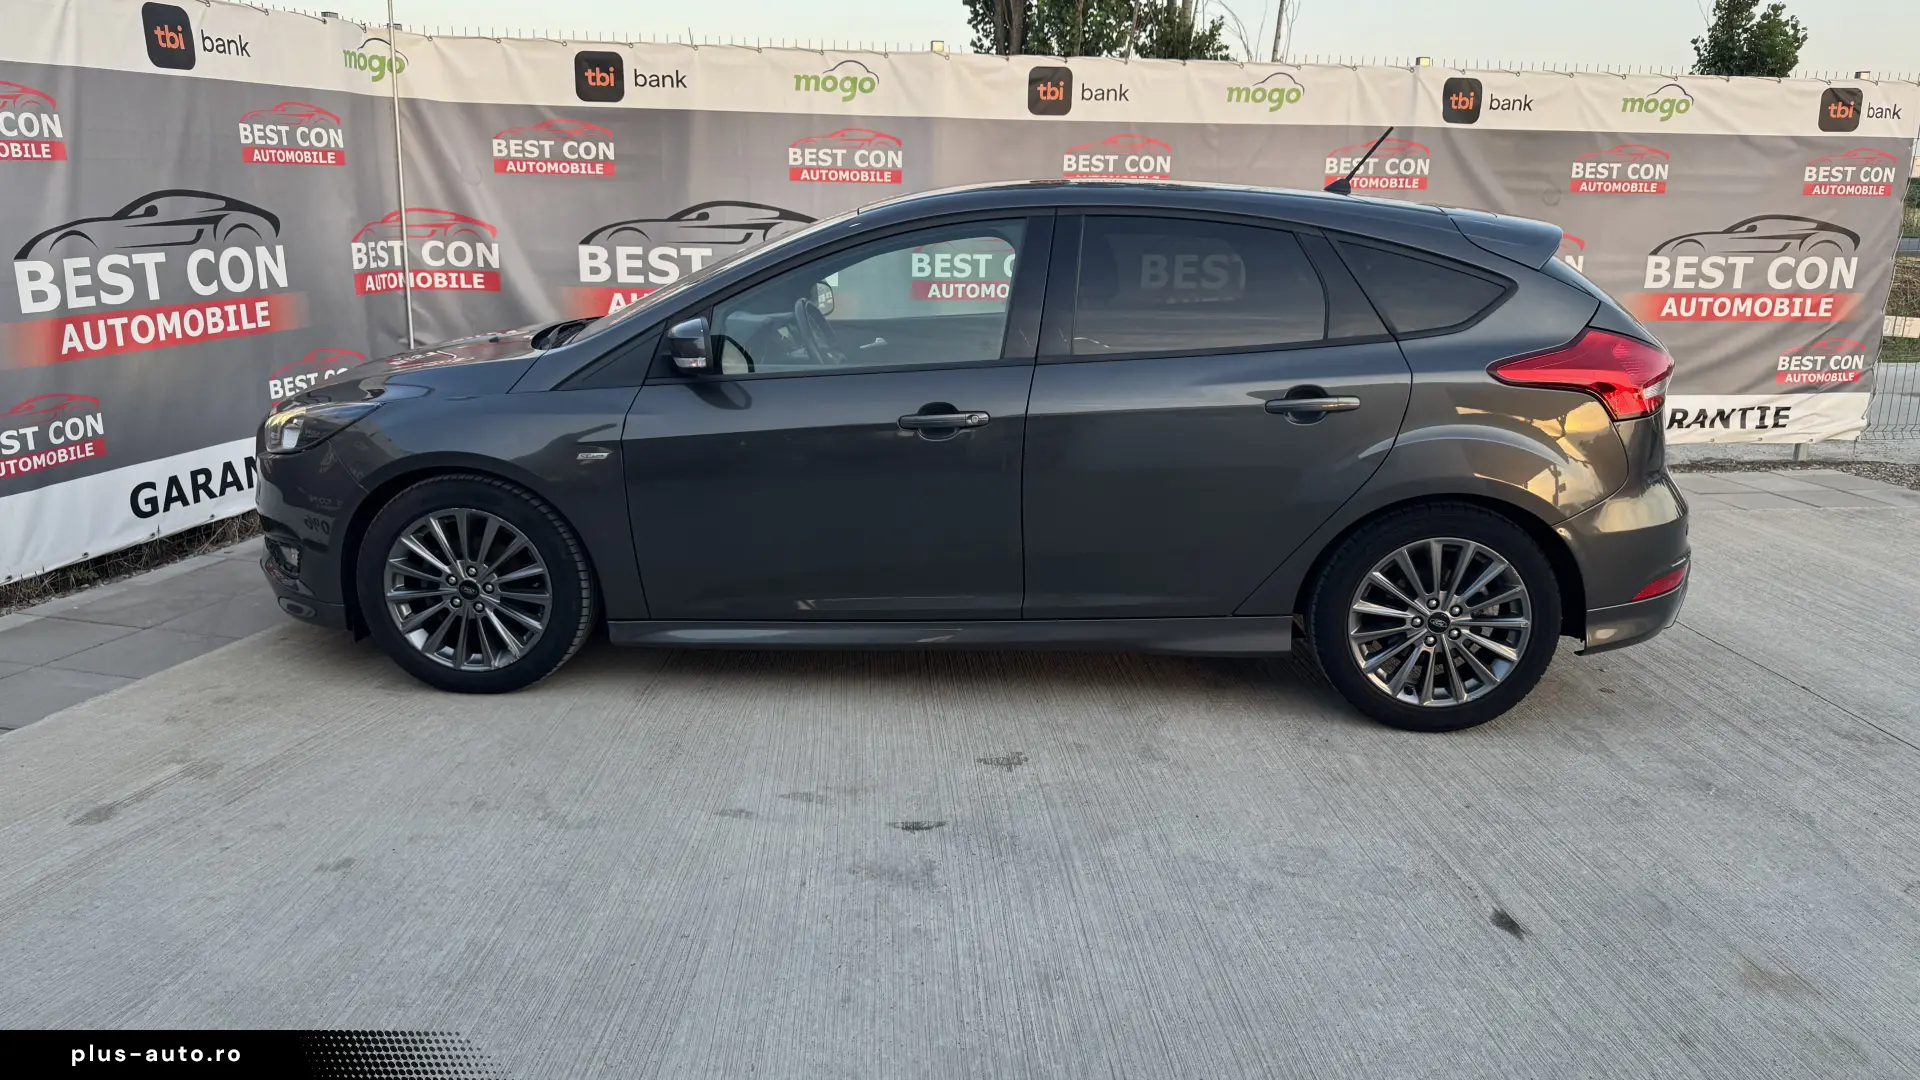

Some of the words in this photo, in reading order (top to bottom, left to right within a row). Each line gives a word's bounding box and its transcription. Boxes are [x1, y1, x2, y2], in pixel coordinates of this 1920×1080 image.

[154, 24, 186, 51] tbi
[201, 29, 251, 58] bank
[343, 49, 406, 82] mogo
[584, 66, 615, 88] tbi
[634, 69, 688, 89] bank
[793, 74, 876, 102] mogo
[1036, 81, 1065, 101] tbi
[1080, 83, 1130, 102] bank
[1226, 85, 1301, 112] mogo
[1449, 91, 1475, 111] tbi
[1488, 93, 1534, 112] bank
[1621, 95, 1691, 122] mogo
[1828, 101, 1855, 119] tbi
[1866, 102, 1902, 121] bank
[0, 111, 63, 138] CON
[239, 123, 290, 147] BEST
[296, 127, 344, 149] CON
[252, 149, 336, 165] AUTOMOBILE
[492, 139, 554, 160] BEST
[562, 141, 615, 161] CON
[788, 148, 847, 167] BEST
[853, 150, 903, 168] CON
[505, 160, 604, 175] AUTOMOBILE
[1063, 154, 1119, 173] BEST
[1124, 155, 1172, 173] CON
[1325, 157, 1379, 175] BEST
[1385, 158, 1430, 176] CON
[1571, 162, 1622, 180] BEST
[1627, 163, 1669, 180] CON
[1804, 166, 1856, 183] BEST
[1860, 167, 1896, 183] CON
[800, 168, 892, 183] AUTOMOBILE
[1579, 181, 1658, 193] AUTOMOBILE
[1812, 185, 1885, 196] AUTOMOBILE
[351, 240, 404, 270] BEST
[421, 240, 500, 269] CON
[578, 245, 713, 285] BEST
[911, 253, 993, 278] BEST
[13, 251, 167, 314] BEST
[186, 244, 289, 297] CON
[365, 272, 486, 292] AUTOMOBILE
[1643, 256, 1757, 290] BEST
[1766, 256, 1859, 290] CON
[1660, 297, 1834, 318] AUTOMOBILE
[61, 301, 272, 355] AUTOMOBILE
[1777, 357, 1824, 371] BEST
[1829, 355, 1864, 370] CON
[268, 372, 318, 400] BEST
[1784, 371, 1855, 384] AUTOMOBILE
[48, 412, 105, 445] CON
[1666, 406, 1792, 430] RANTIE
